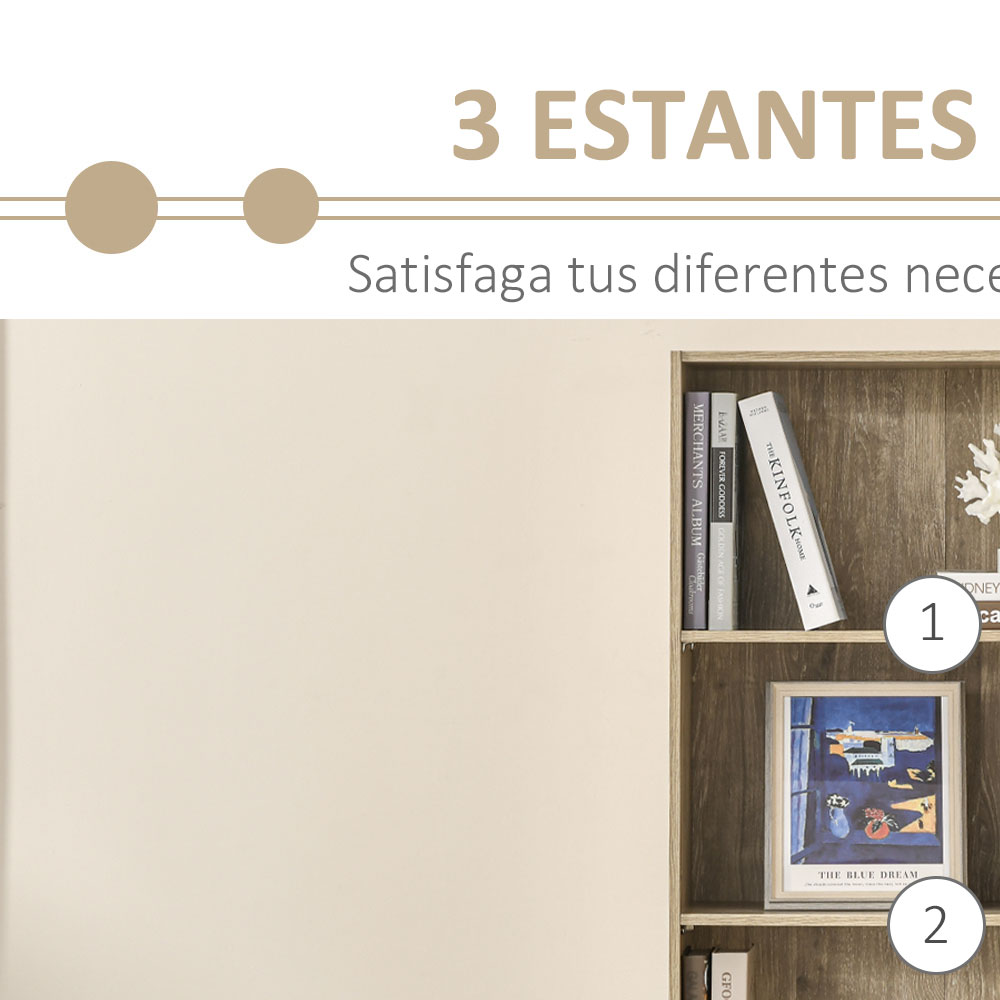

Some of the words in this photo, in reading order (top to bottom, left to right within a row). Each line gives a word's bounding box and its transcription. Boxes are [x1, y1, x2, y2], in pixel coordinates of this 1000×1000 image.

[692, 403, 704, 489] MERCHANTS
[766, 442, 775, 459] THE
[718, 451, 726, 482] FOREVER
[718, 483, 726, 518] GODDESS
[768, 458, 803, 540] KINFOLK
[691, 498, 703, 546] ALBUM
[795, 537, 806, 561] HOME
[961, 582, 1000, 594] DNEY
[817, 871, 841, 879] THE
[846, 871, 875, 879] BLUE
[880, 870, 918, 879] DREAM
